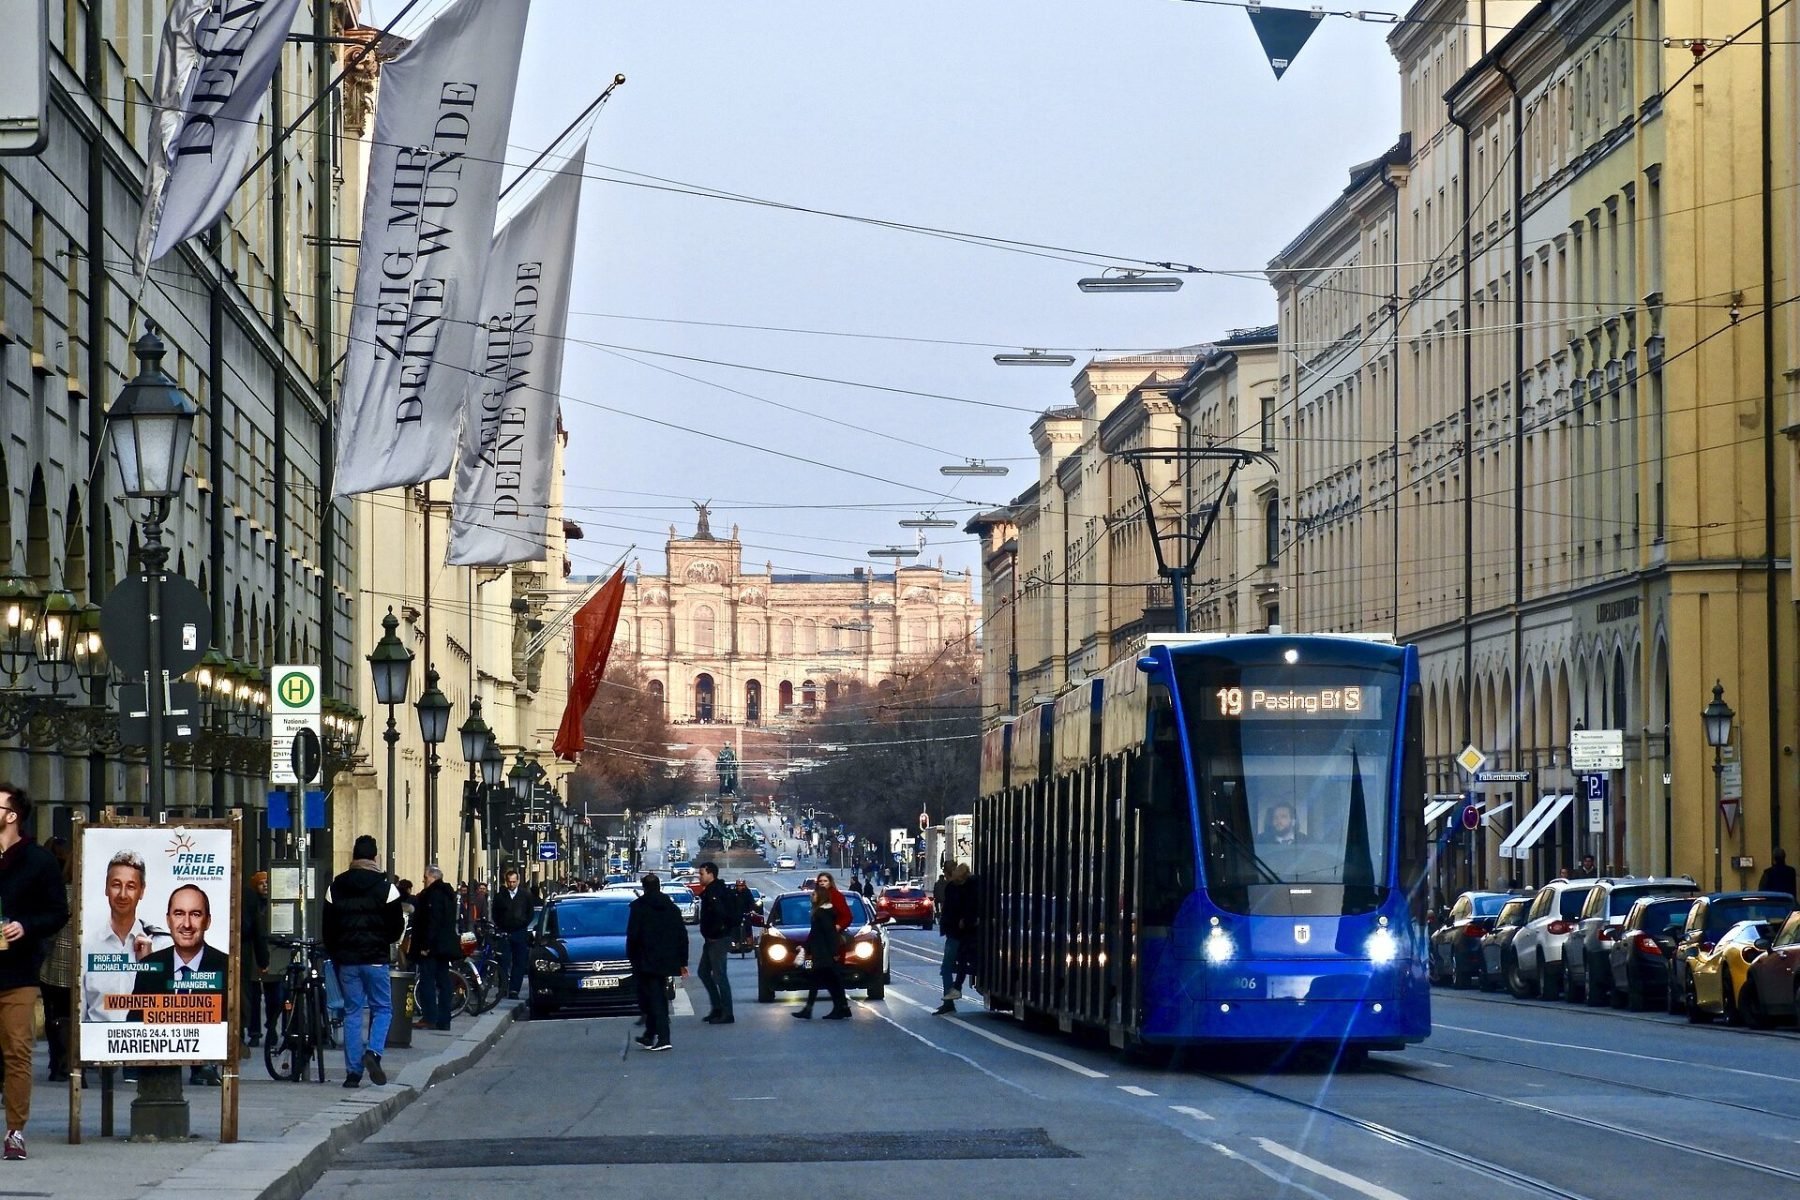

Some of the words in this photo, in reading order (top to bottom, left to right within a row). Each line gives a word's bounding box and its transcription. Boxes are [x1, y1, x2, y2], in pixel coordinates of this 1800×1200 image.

[416, 82, 478, 263] WUNDE
[387, 144, 430, 233] MIR
[374, 247, 414, 361] ZEIG
[504, 262, 542, 398] WUNDE
[395, 278, 446, 430] DEINE
[485, 312, 513, 378] MIR
[472, 388, 504, 469] ZEIG
[493, 407, 526, 520] DEINE
[289, 680, 303, 700] H
[1216, 688, 1242, 715] 19
[1252, 689, 1317, 713] Pasing
[1321, 690, 1341, 709] Bf
[1590, 776, 1599, 796] P
[178, 853, 215, 863] FREIE
[173, 863, 224, 875] WÄHLER
[93, 954, 111, 962] PROF.
[112, 954, 123, 962] DR.
[93, 963, 121, 971] MICHAEL
[122, 963, 149, 971] PIAZOLO
[173, 981, 208, 989] AIWANGER
[190, 972, 216, 980] HUBERT
[108, 996, 159, 1009] WOHNEN.
[162, 996, 215, 1008] BILDUNG.
[147, 1011, 215, 1023] SICHERHEIT.
[107, 1029, 147, 1038] DIENSTAG
[149, 1029, 169, 1038] 24.4.
[171, 1029, 181, 1037] 13
[183, 1029, 200, 1038] UHR
[108, 1039, 200, 1053] MARIENPLATZ
